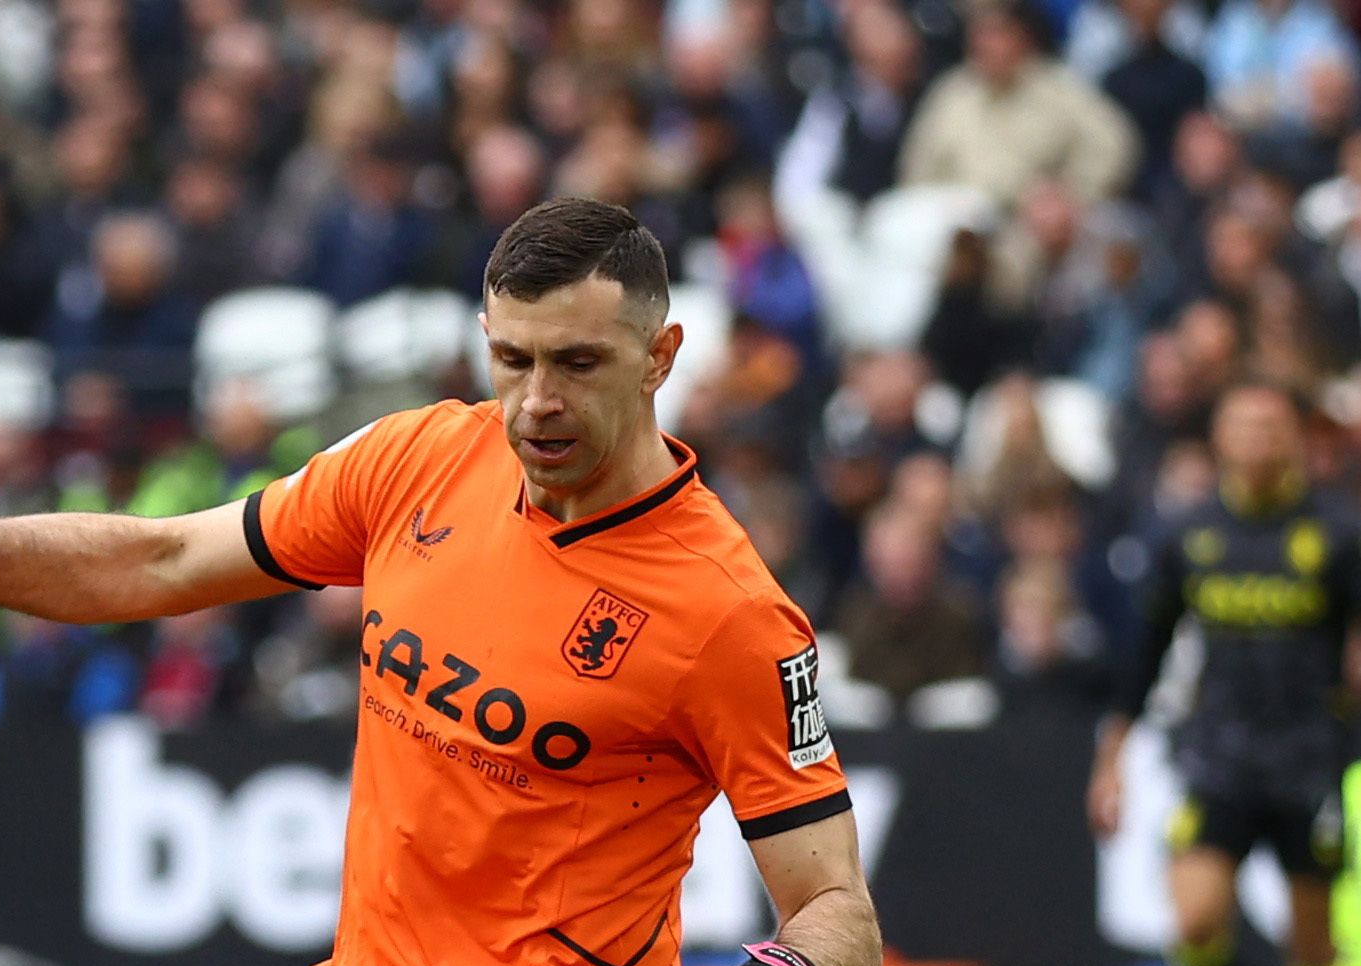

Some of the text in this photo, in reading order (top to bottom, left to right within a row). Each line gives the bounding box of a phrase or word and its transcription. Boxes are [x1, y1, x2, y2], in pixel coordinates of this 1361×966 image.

[593, 596, 642, 628] AVFC
[363, 686, 534, 790] earch. Drive. Smile.
